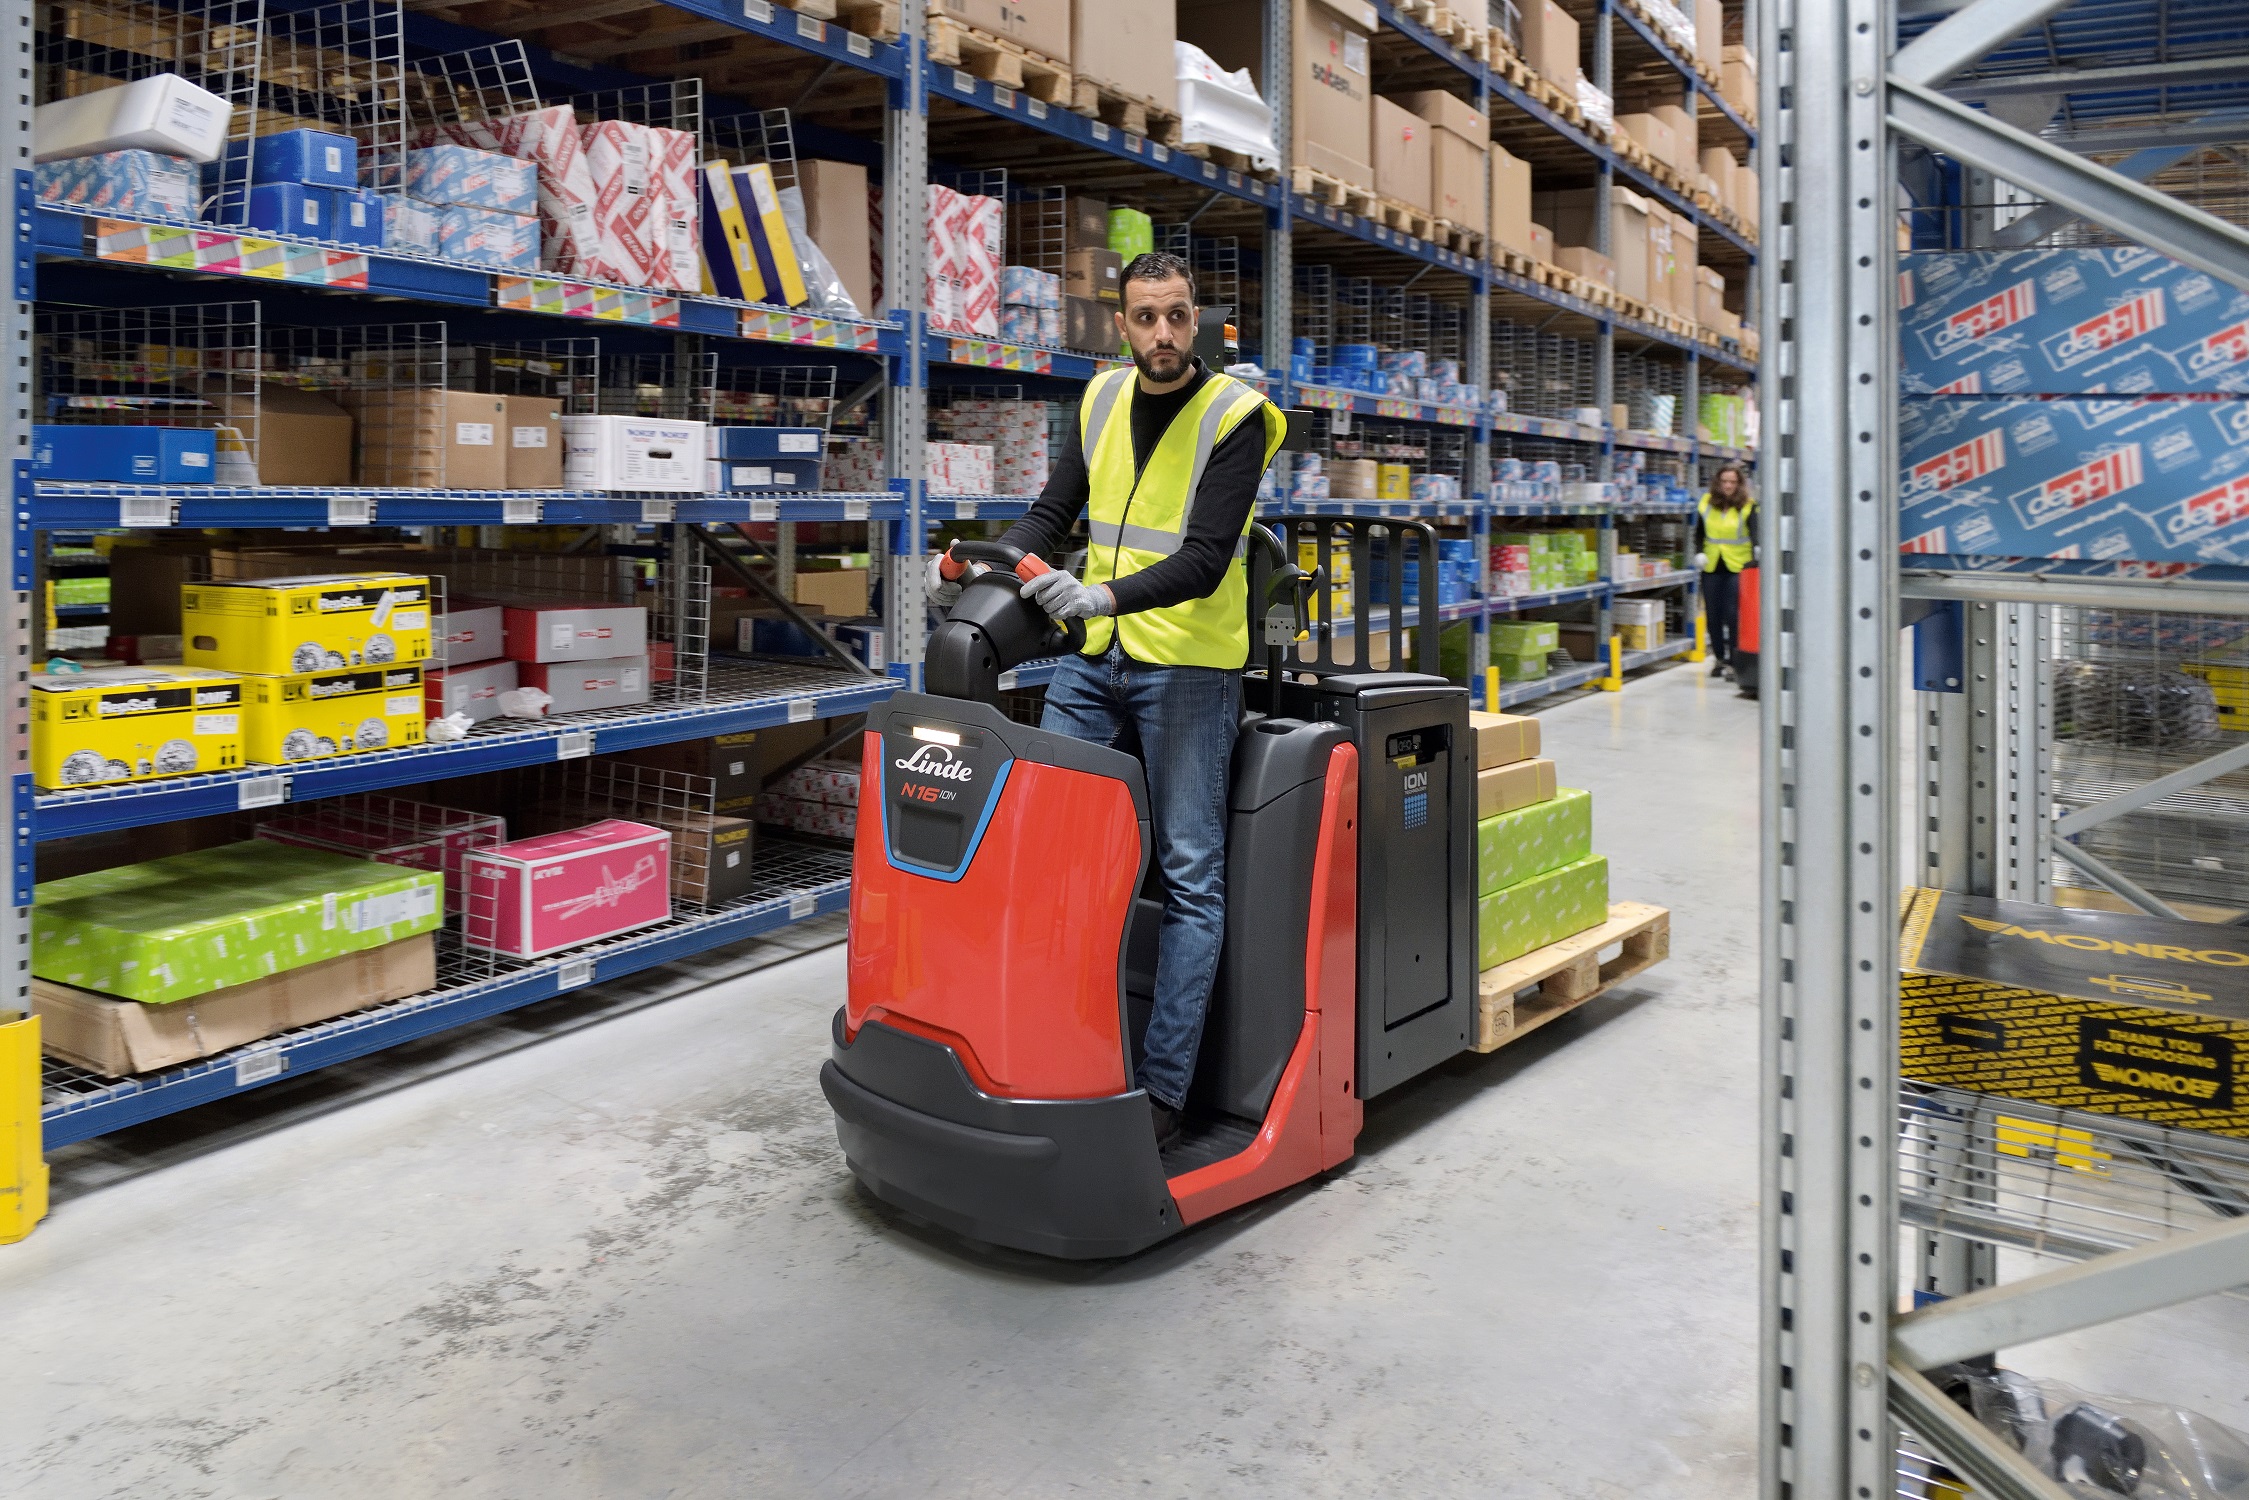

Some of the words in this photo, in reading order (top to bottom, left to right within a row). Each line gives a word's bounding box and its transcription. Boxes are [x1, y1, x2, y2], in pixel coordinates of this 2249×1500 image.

[319, 595, 363, 610] RepSet
[98, 698, 157, 715] RepSet
[195, 691, 232, 705] DMF
[895, 744, 973, 782] Linde
[1404, 771, 1427, 791] ION
[2094, 1039, 2125, 1054] FOR
[2127, 1045, 2218, 1070] CHOOSING
[2091, 1062, 2221, 1099] MONROE
